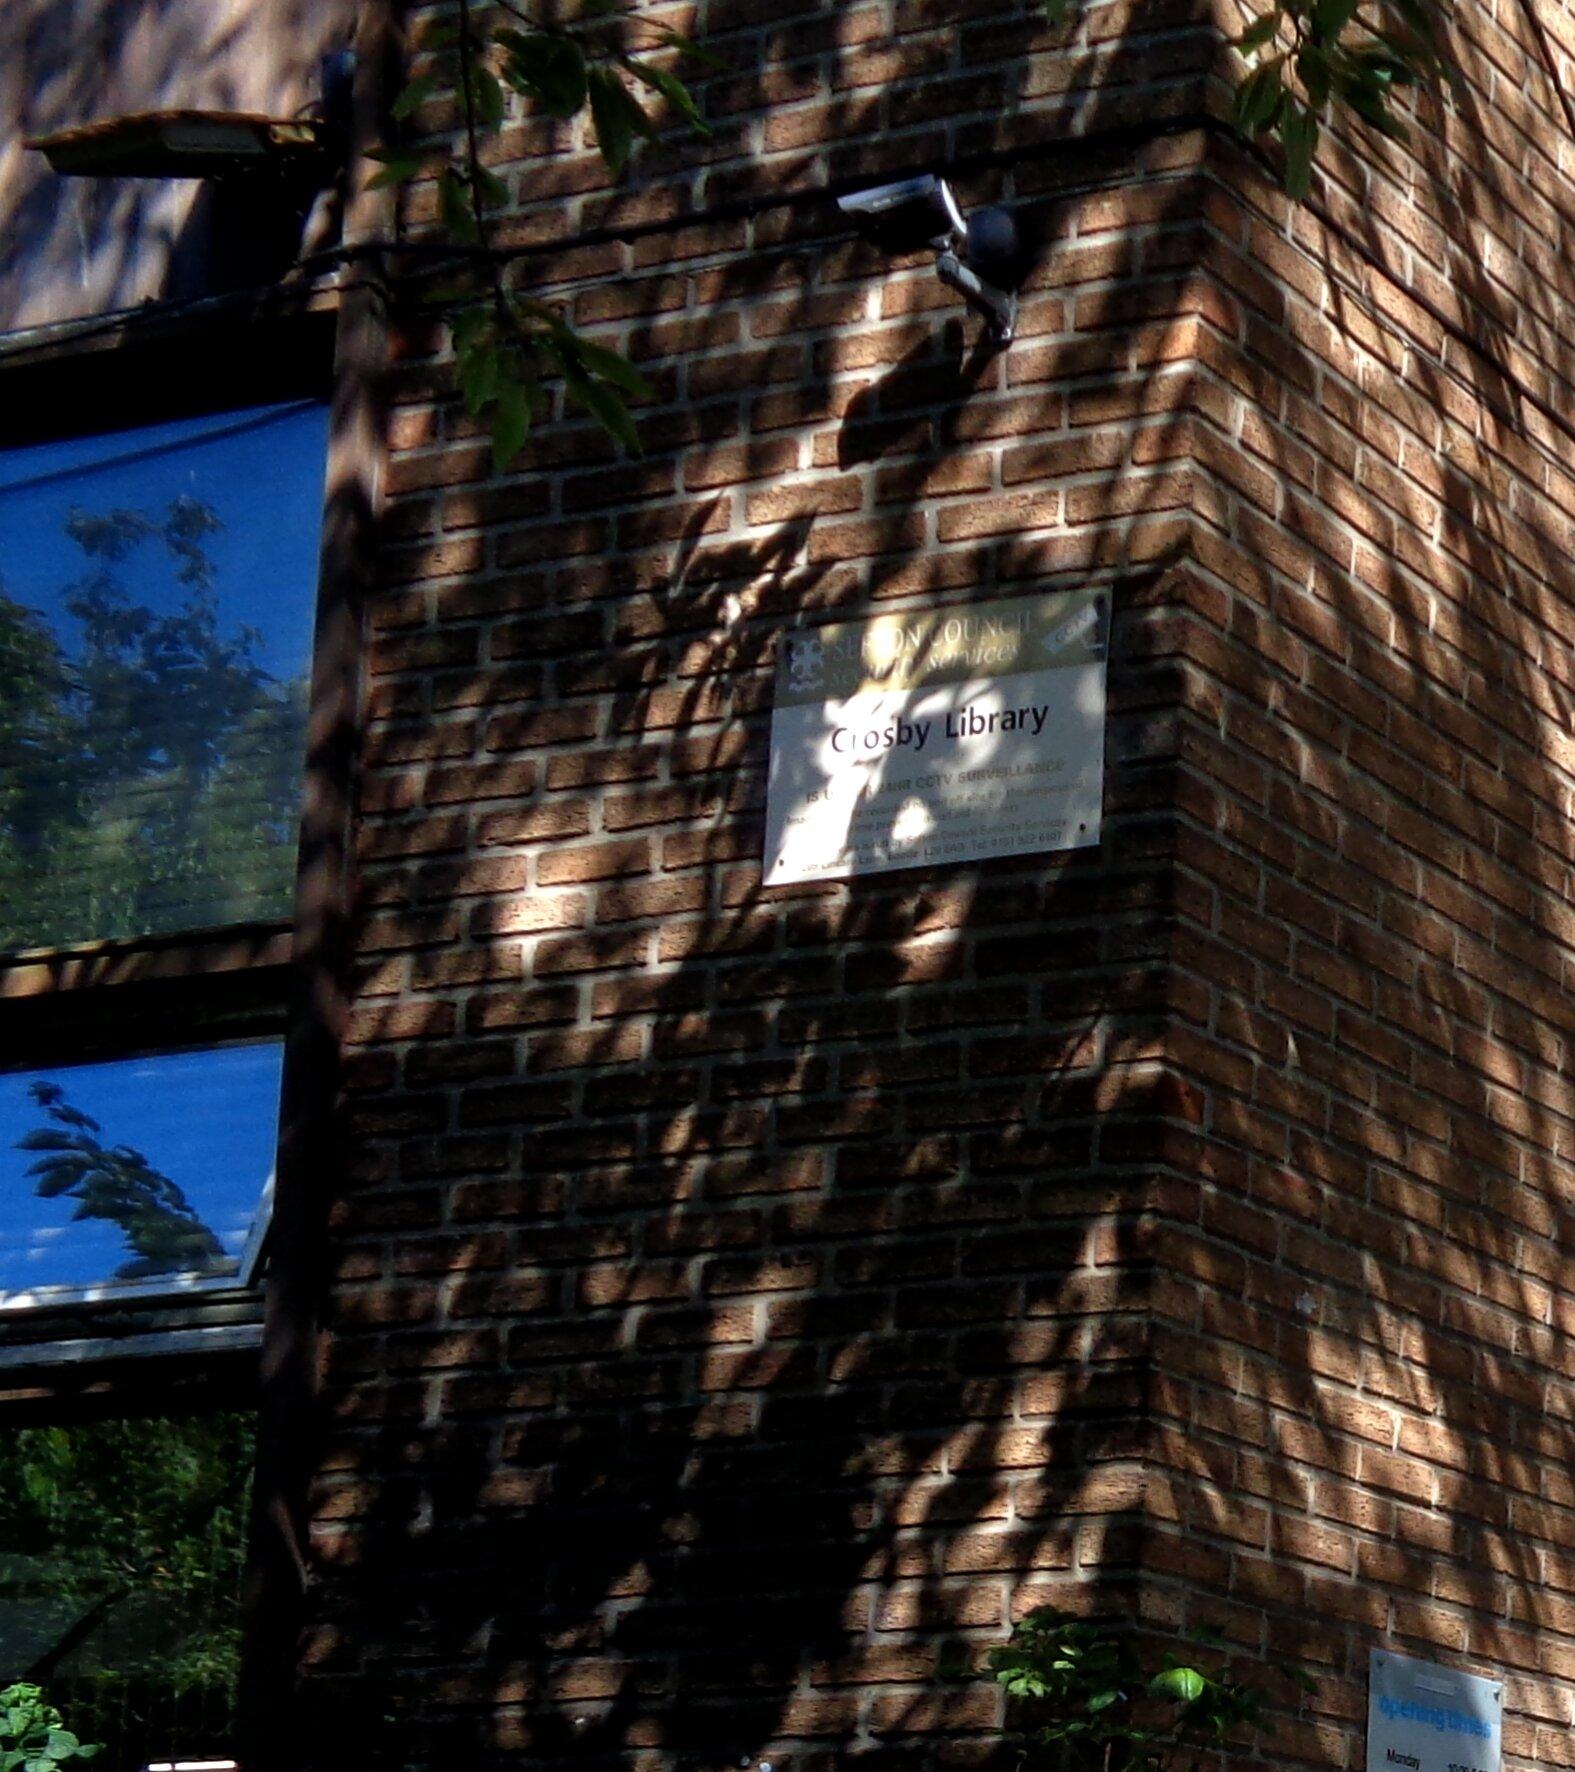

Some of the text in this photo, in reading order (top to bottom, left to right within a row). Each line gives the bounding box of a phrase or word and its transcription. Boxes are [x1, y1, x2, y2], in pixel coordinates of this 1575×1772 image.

[831, 704, 1049, 752] Crosby Library
[915, 773, 953, 789] CCTV
[957, 758, 1066, 784] SURVEILLANCE
[1387, 1749, 1420, 1771] Monday
